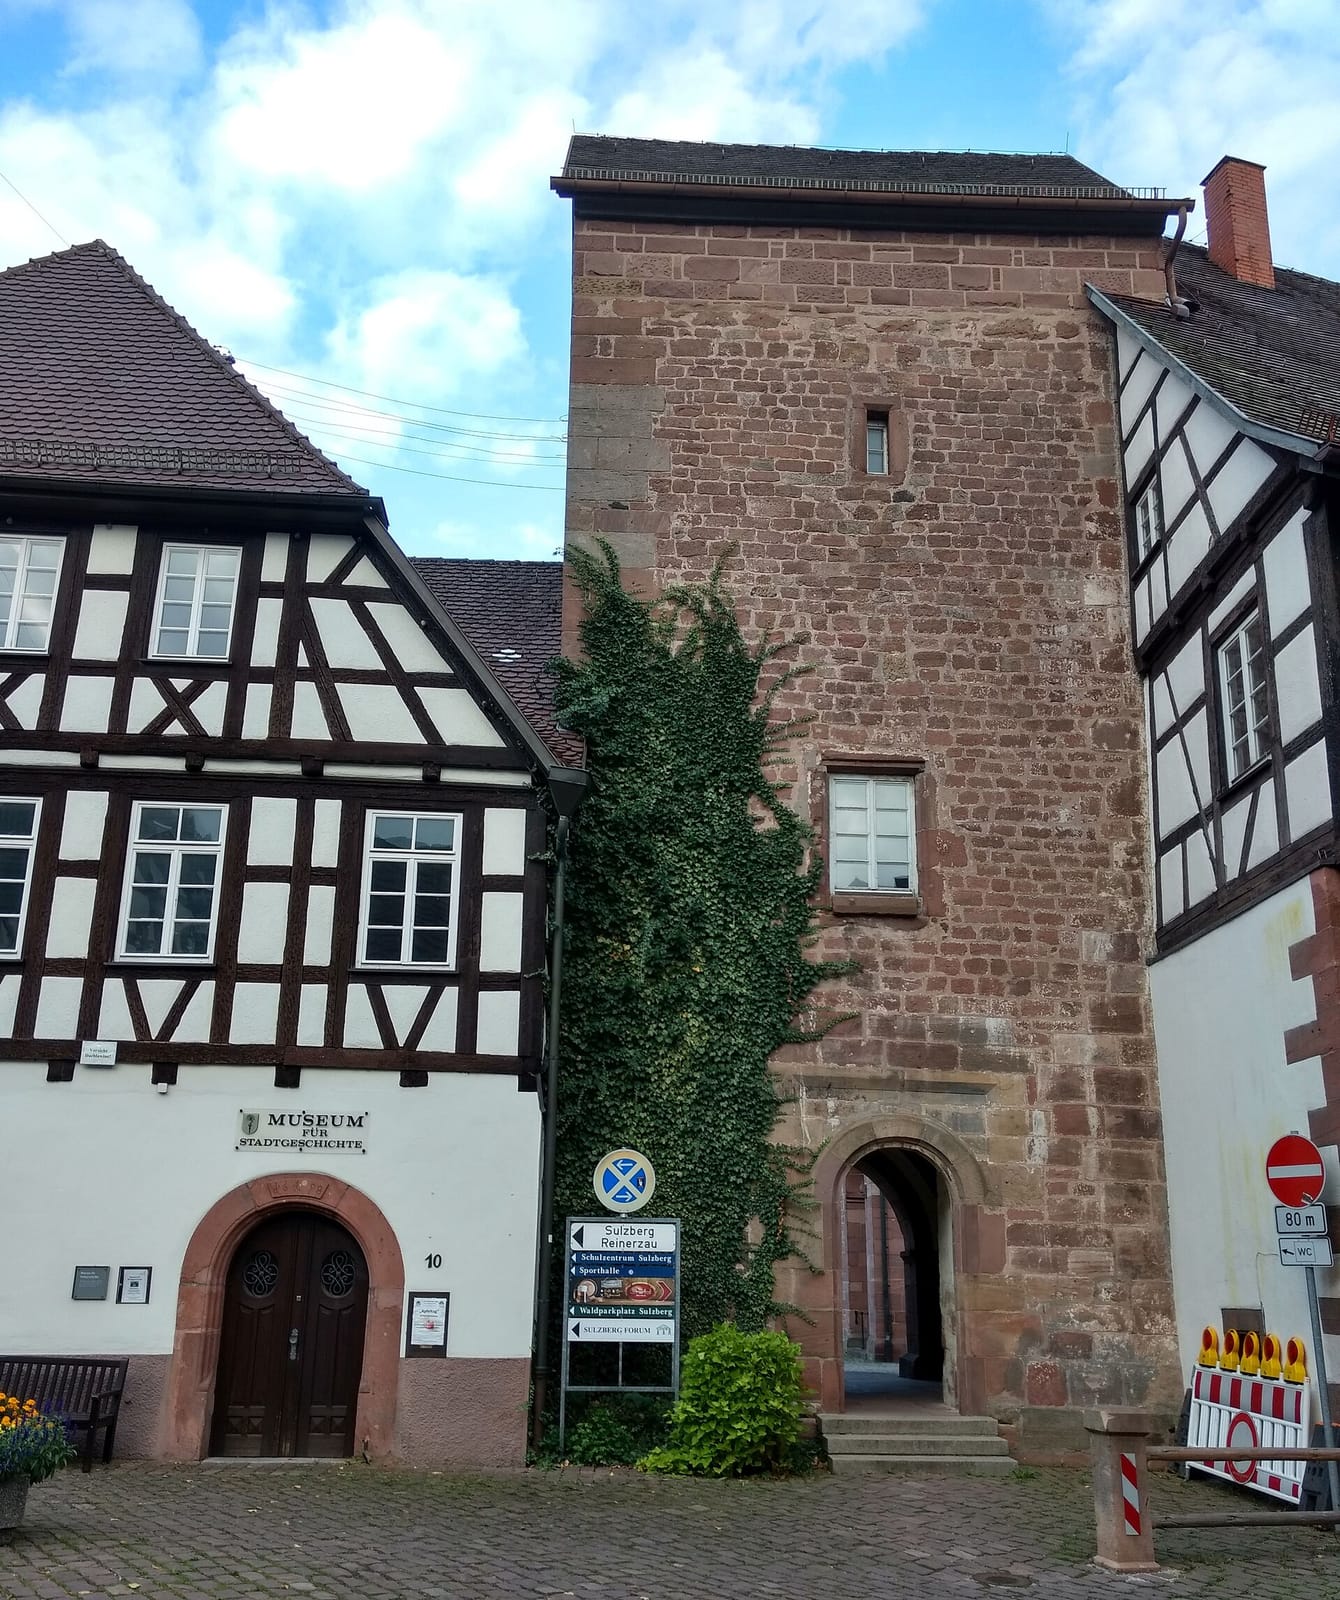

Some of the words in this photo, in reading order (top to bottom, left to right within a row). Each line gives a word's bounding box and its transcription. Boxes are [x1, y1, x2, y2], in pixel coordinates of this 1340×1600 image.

[267, 1113, 364, 1128] MUSEUM
[302, 1127, 328, 1137] FÜR
[239, 1137, 363, 1149] STADTGESCHICHTE
[1285, 1212, 1301, 1227] 80
[1305, 1215, 1315, 1227] m
[605, 1225, 655, 1238] Sulzberg
[601, 1238, 657, 1249] Reinerzau
[1297, 1247, 1313, 1257] WC
[424, 1252, 442, 1269] 10
[581, 1253, 635, 1262] Schulzentrum
[638, 1255, 672, 1264] Sulzberg
[579, 1266, 620, 1276] Sporthalle
[579, 1306, 636, 1317] Waldparkplatz
[639, 1307, 673, 1317] Sulzberg
[583, 1326, 623, 1334] SULZBERG
